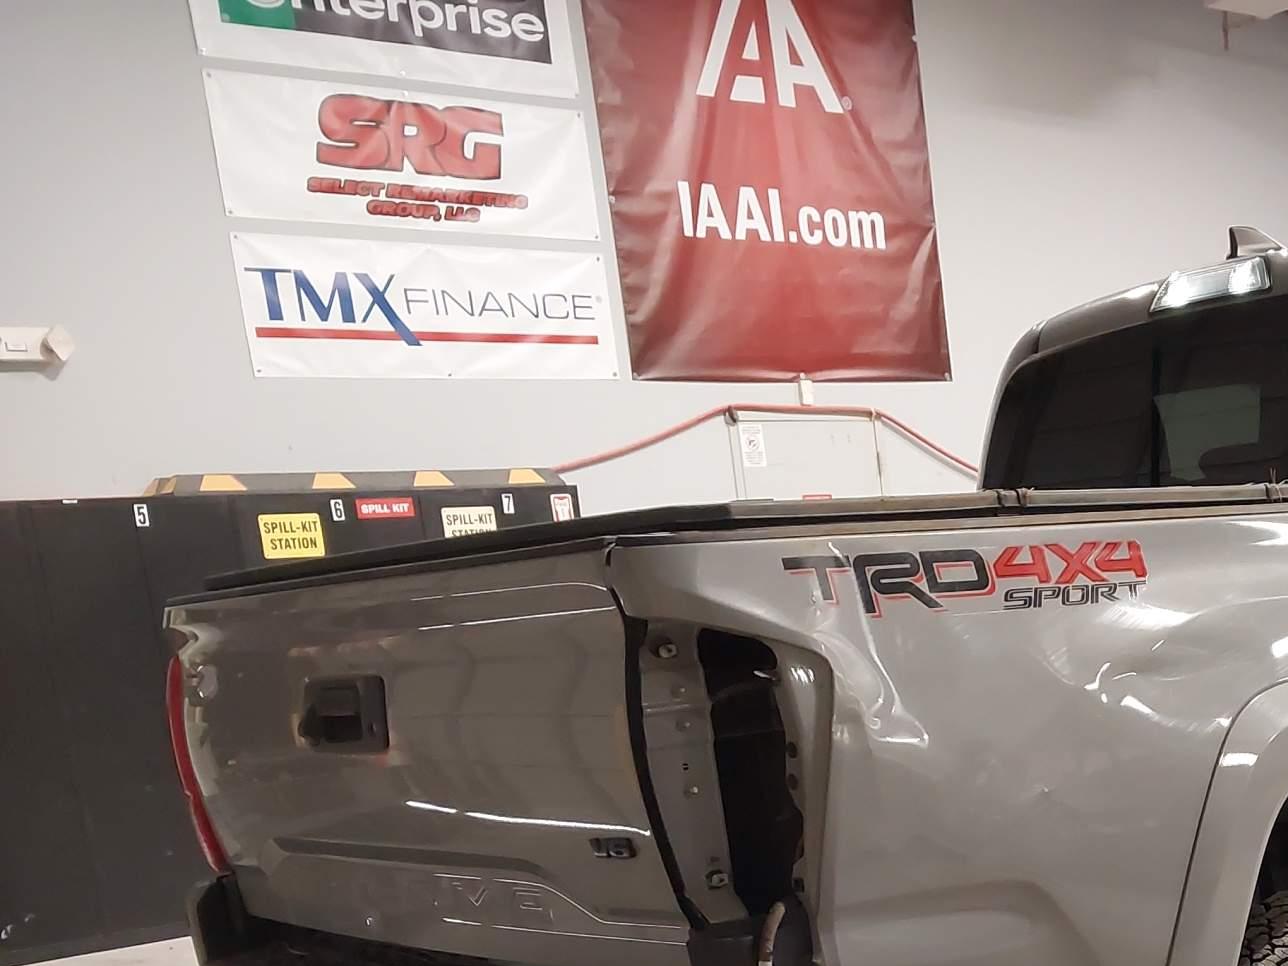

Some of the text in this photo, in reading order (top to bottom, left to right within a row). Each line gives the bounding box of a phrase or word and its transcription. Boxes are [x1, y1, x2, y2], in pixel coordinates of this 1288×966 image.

[247, 0, 546, 42] erprise
[316, 93, 504, 180] SRG
[307, 177, 529, 209] SELECT REMARKETING
[367, 200, 481, 222] GROUP, LLC
[677, 180, 886, 250] IAAI.com
[244, 267, 596, 347] TMX FINANCE
[333, 500, 344, 519] 6
[360, 502, 411, 514] SPILL KIT
[503, 495, 512, 512] 7
[136, 506, 147, 526] 5
[263, 520, 319, 534] SPILL-KIT
[446, 512, 494, 526] SPILL-KIT
[269, 537, 318, 551] STATION
[781, 548, 997, 619] TRD
[1003, 580, 1148, 611] SPORT
